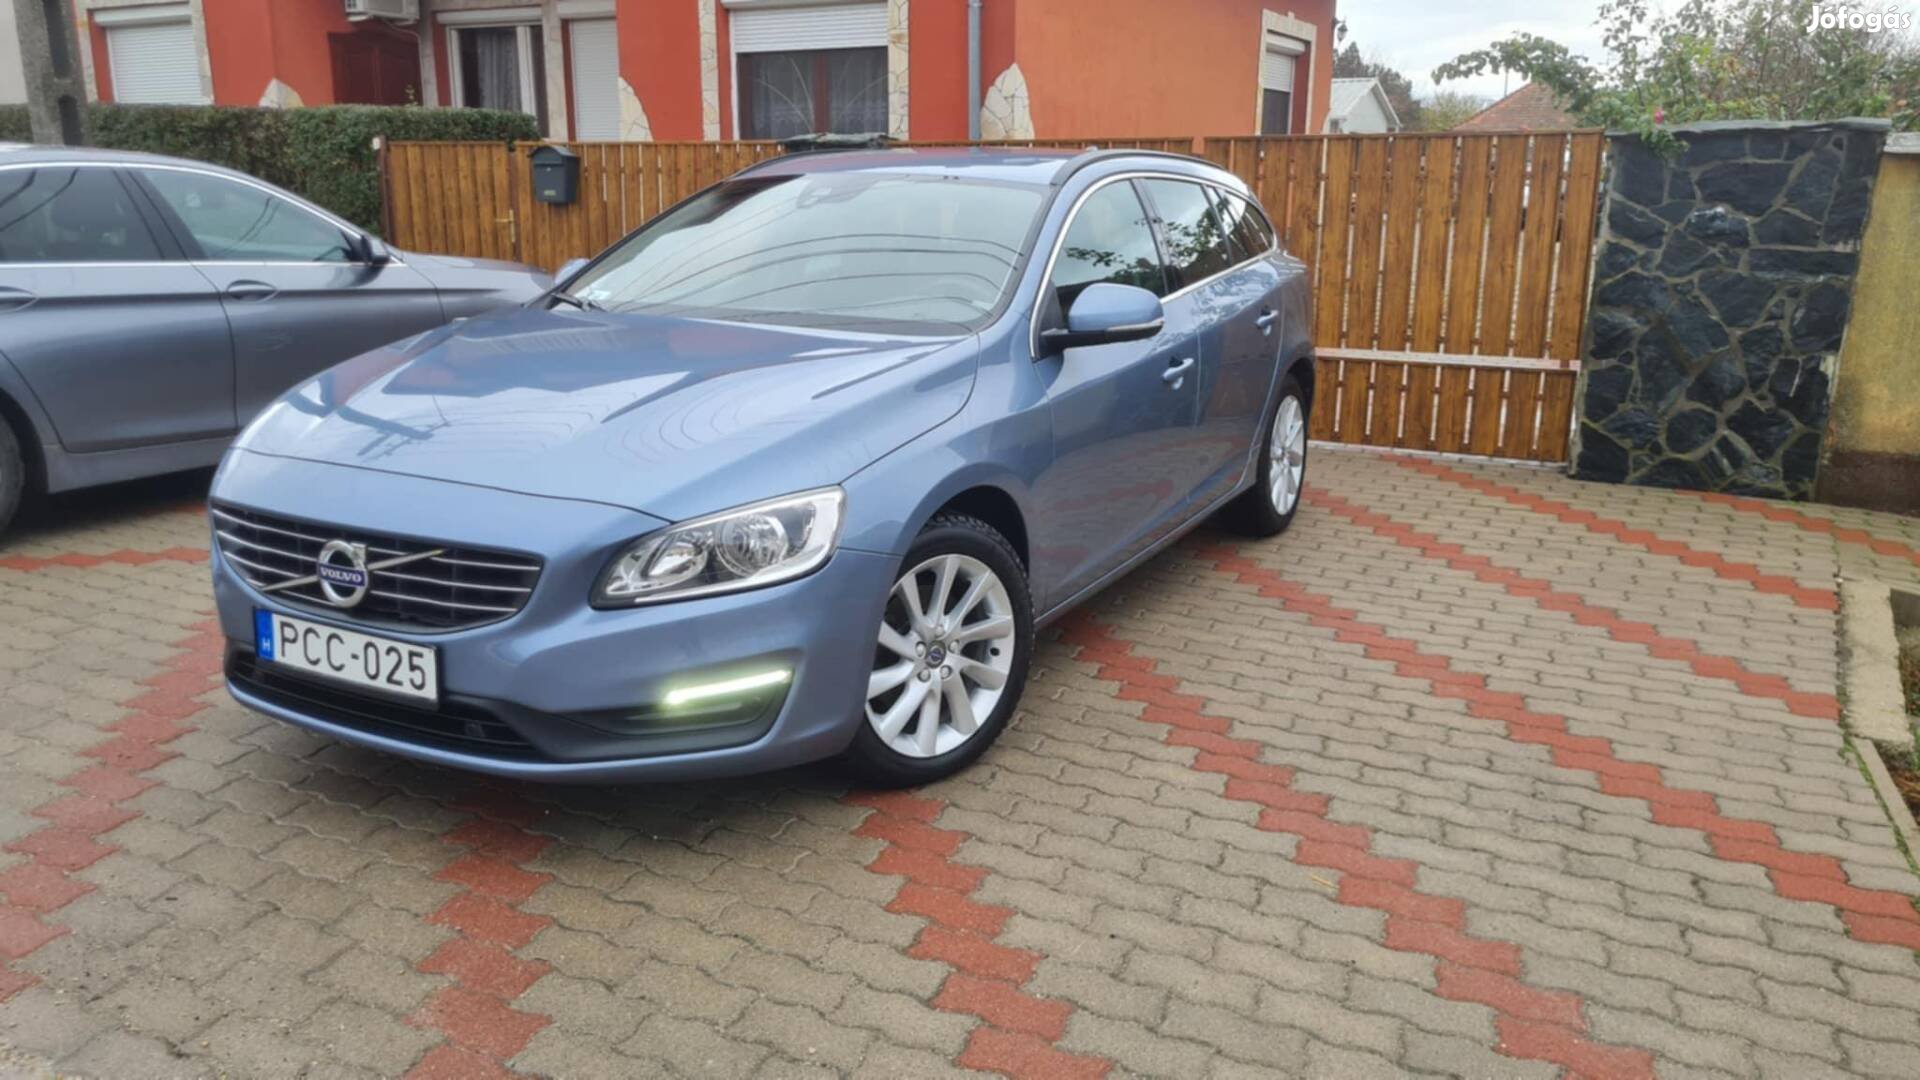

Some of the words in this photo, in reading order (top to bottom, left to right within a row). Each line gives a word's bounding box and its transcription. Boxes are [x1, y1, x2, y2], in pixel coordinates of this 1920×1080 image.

[320, 567, 362, 583] VOLVO
[262, 639, 271, 650] H
[280, 621, 426, 691] PCC-025
